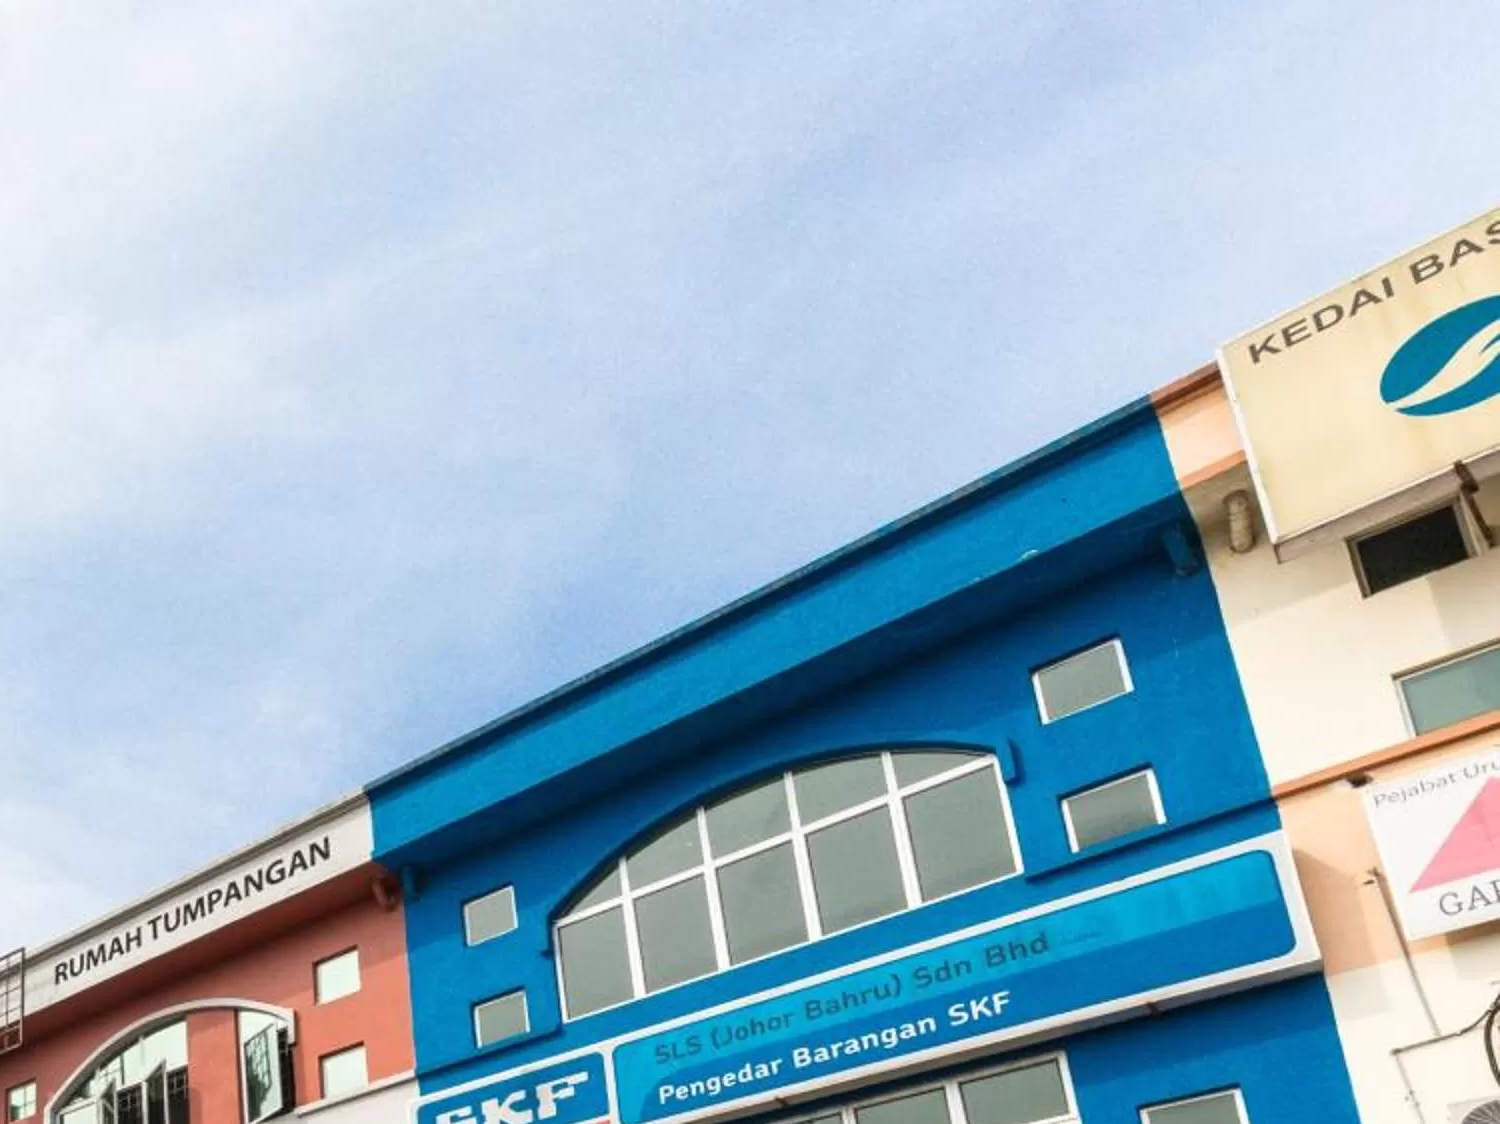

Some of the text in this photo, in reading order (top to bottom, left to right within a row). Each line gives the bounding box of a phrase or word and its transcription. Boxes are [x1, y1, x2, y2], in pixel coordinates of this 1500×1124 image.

[1248, 276, 1395, 364] KEDAI
[1373, 772, 1455, 808] Pejabat
[52, 836, 332, 986] RUMAH TUMPANGAN
[654, 931, 1050, 1066] SLS (Johor Bahru) Sdn Bhd
[659, 990, 1011, 1104] Pengedar Barangan SKF
